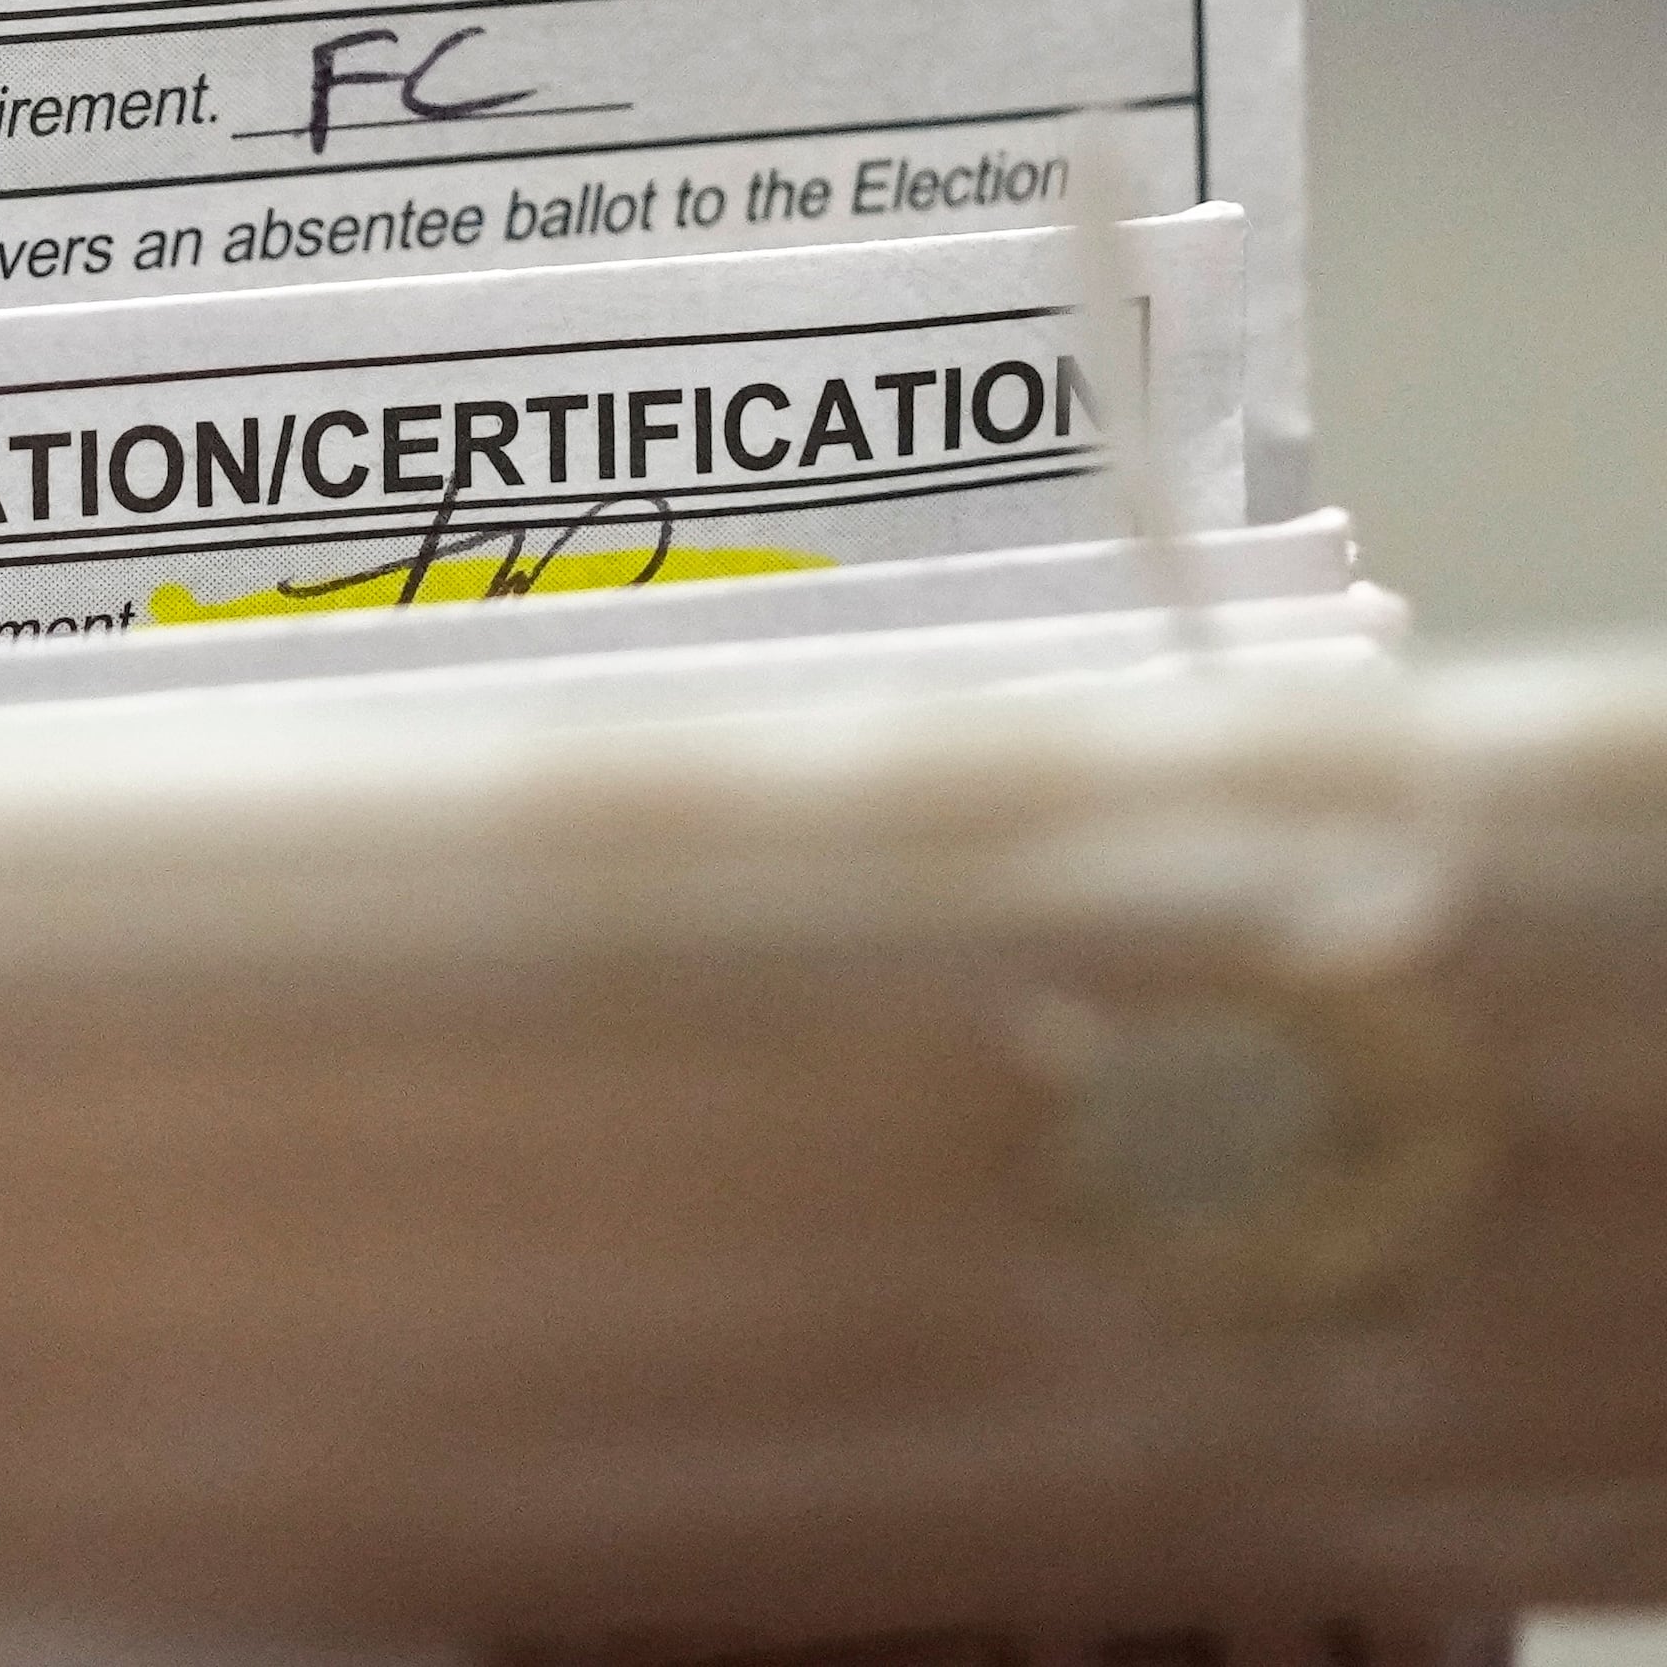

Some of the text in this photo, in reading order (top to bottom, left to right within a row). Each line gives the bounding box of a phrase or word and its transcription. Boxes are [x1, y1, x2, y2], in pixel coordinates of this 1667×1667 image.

[302, 29, 535, 152] FC
[134, 220, 202, 270] an
[224, 202, 483, 263] absentee
[505, 180, 658, 242] ballot
[674, 177, 725, 227] to
[746, 168, 832, 223] the
